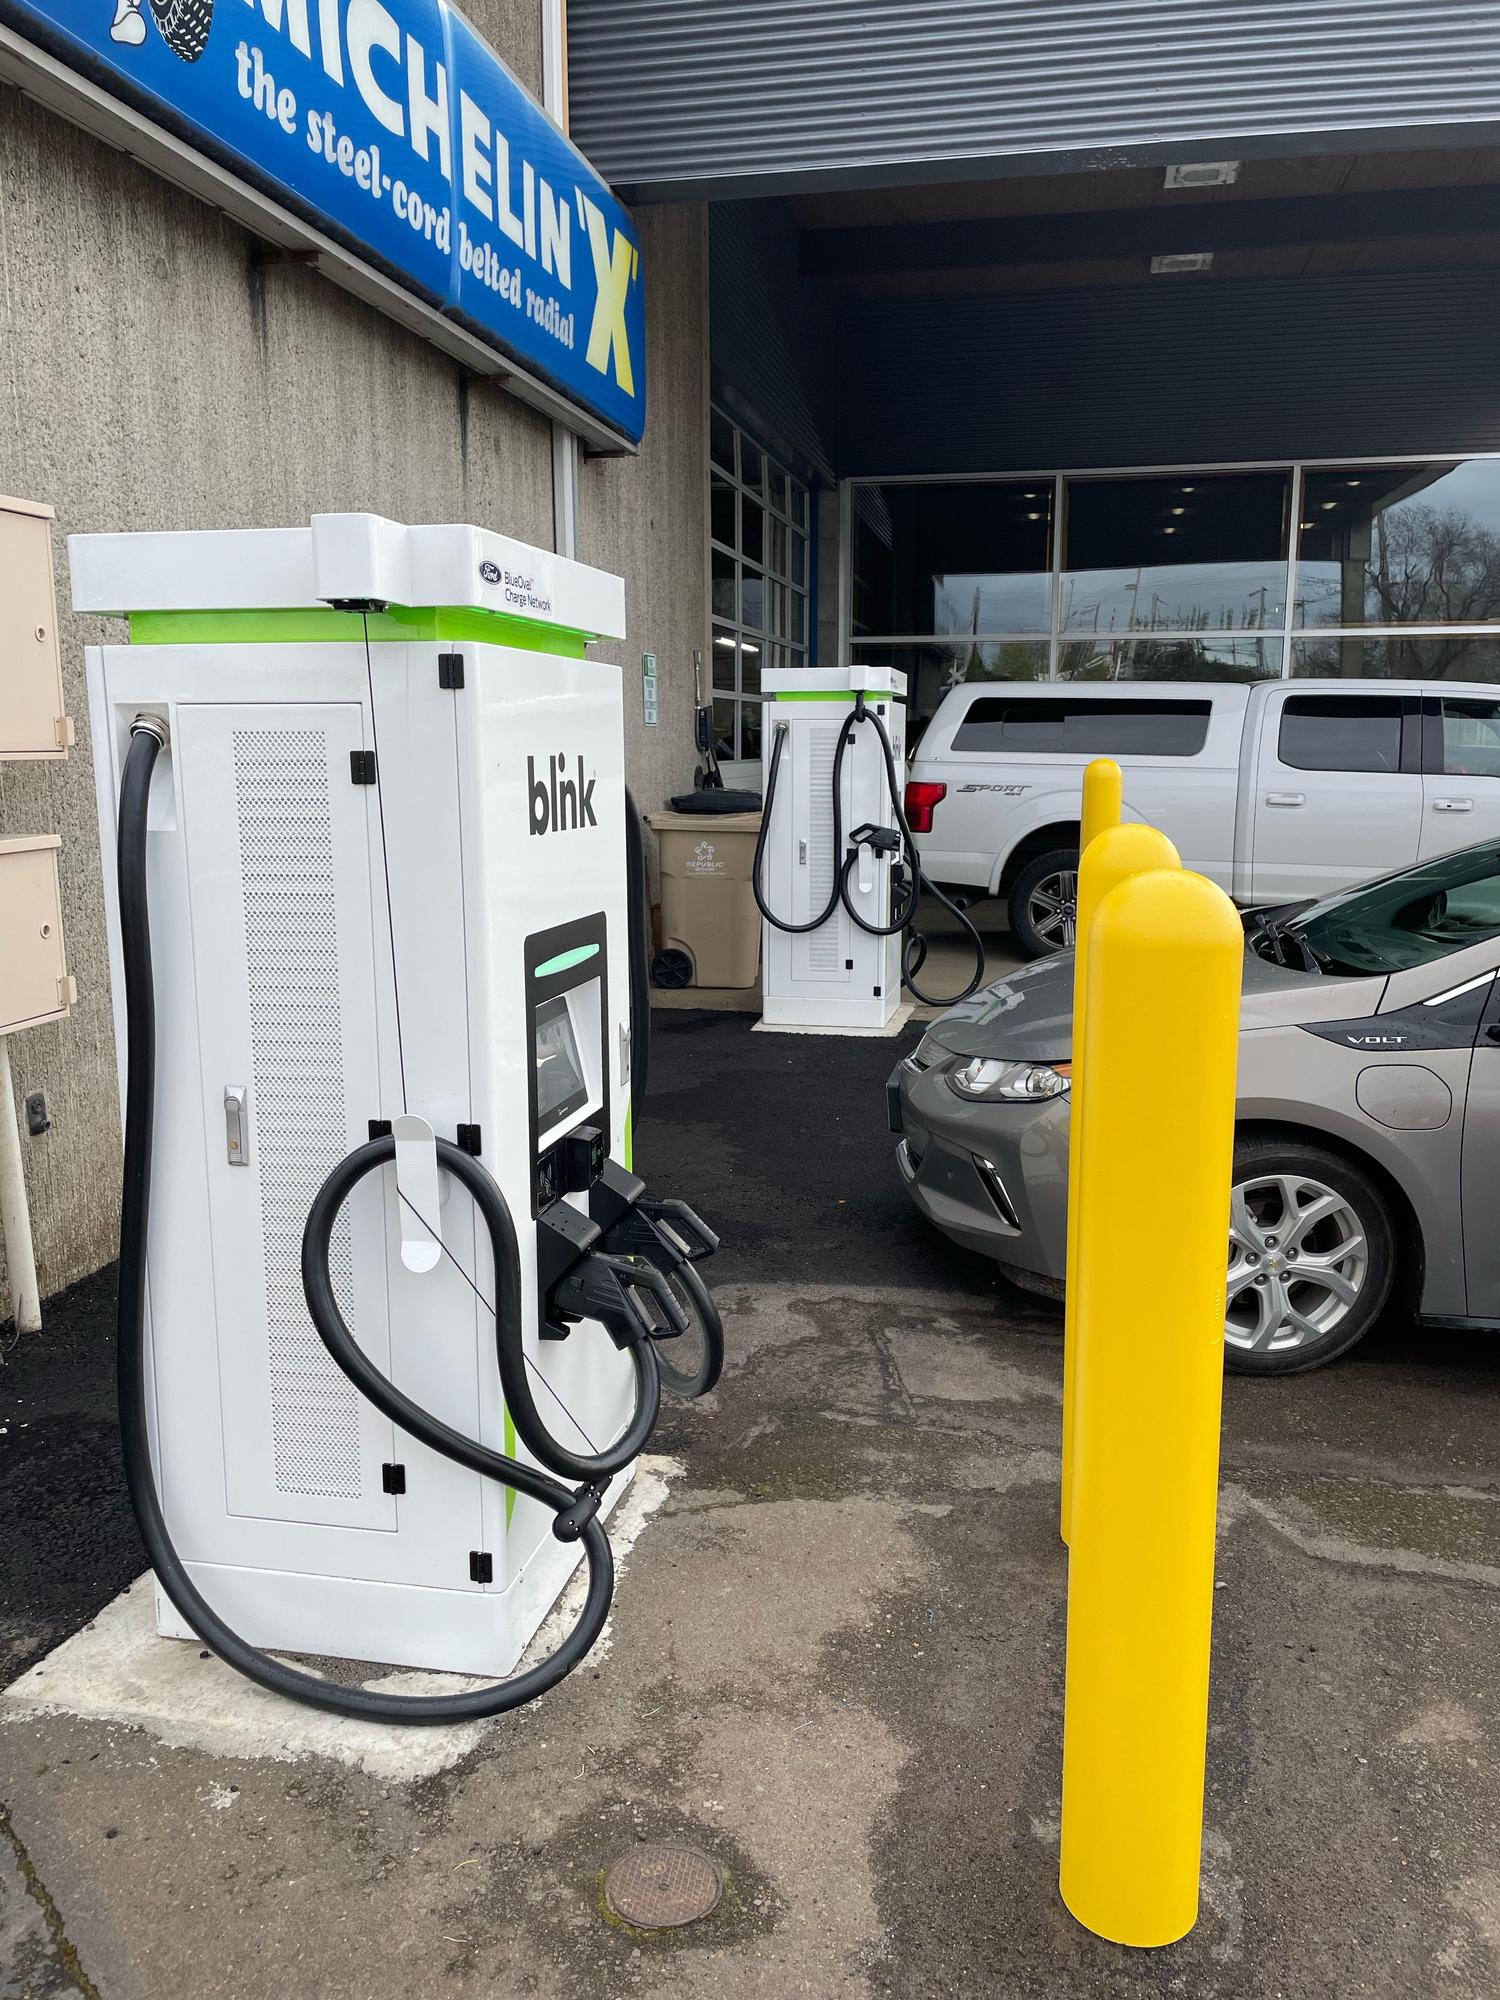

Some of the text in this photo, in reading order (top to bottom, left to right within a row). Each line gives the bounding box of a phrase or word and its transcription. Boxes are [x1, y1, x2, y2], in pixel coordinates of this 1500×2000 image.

[244, 0, 571, 290] ICHELIN
[235, 41, 575, 350] the steel-cord belted radial
[504, 588, 551, 611] Charge Network
[527, 752, 598, 836] blink
[956, 784, 1032, 793] SPORT
[1346, 1034, 1407, 1044] VOLT
